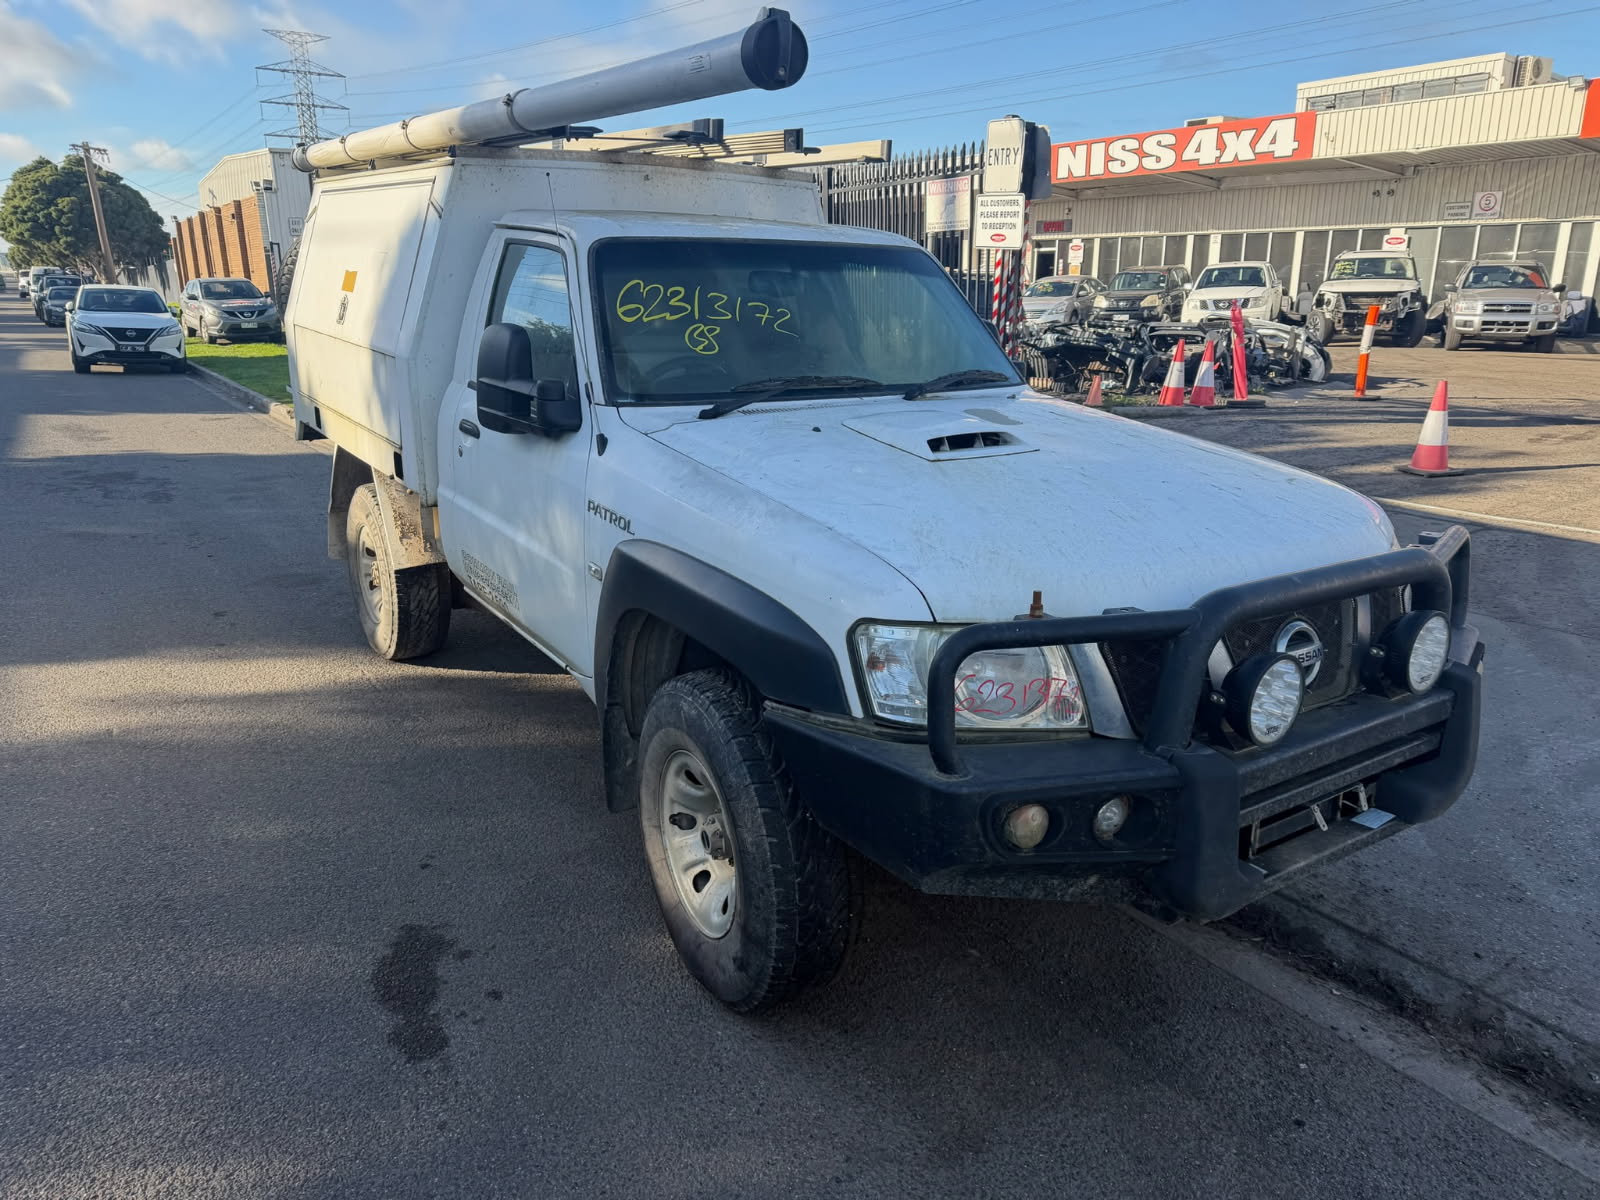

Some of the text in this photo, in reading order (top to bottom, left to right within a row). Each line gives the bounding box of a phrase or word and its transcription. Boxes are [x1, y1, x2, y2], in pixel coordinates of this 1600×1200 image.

[988, 147, 1020, 166] ENTRY
[929, 180, 969, 192] WARNING
[980, 199, 989, 207] ALL
[1485, 196, 1491, 205] 5
[980, 210, 1020, 218] PLEASE REPORT
[981, 222, 1017, 230] TO RECEPTION
[587, 499, 635, 536] PATROL
